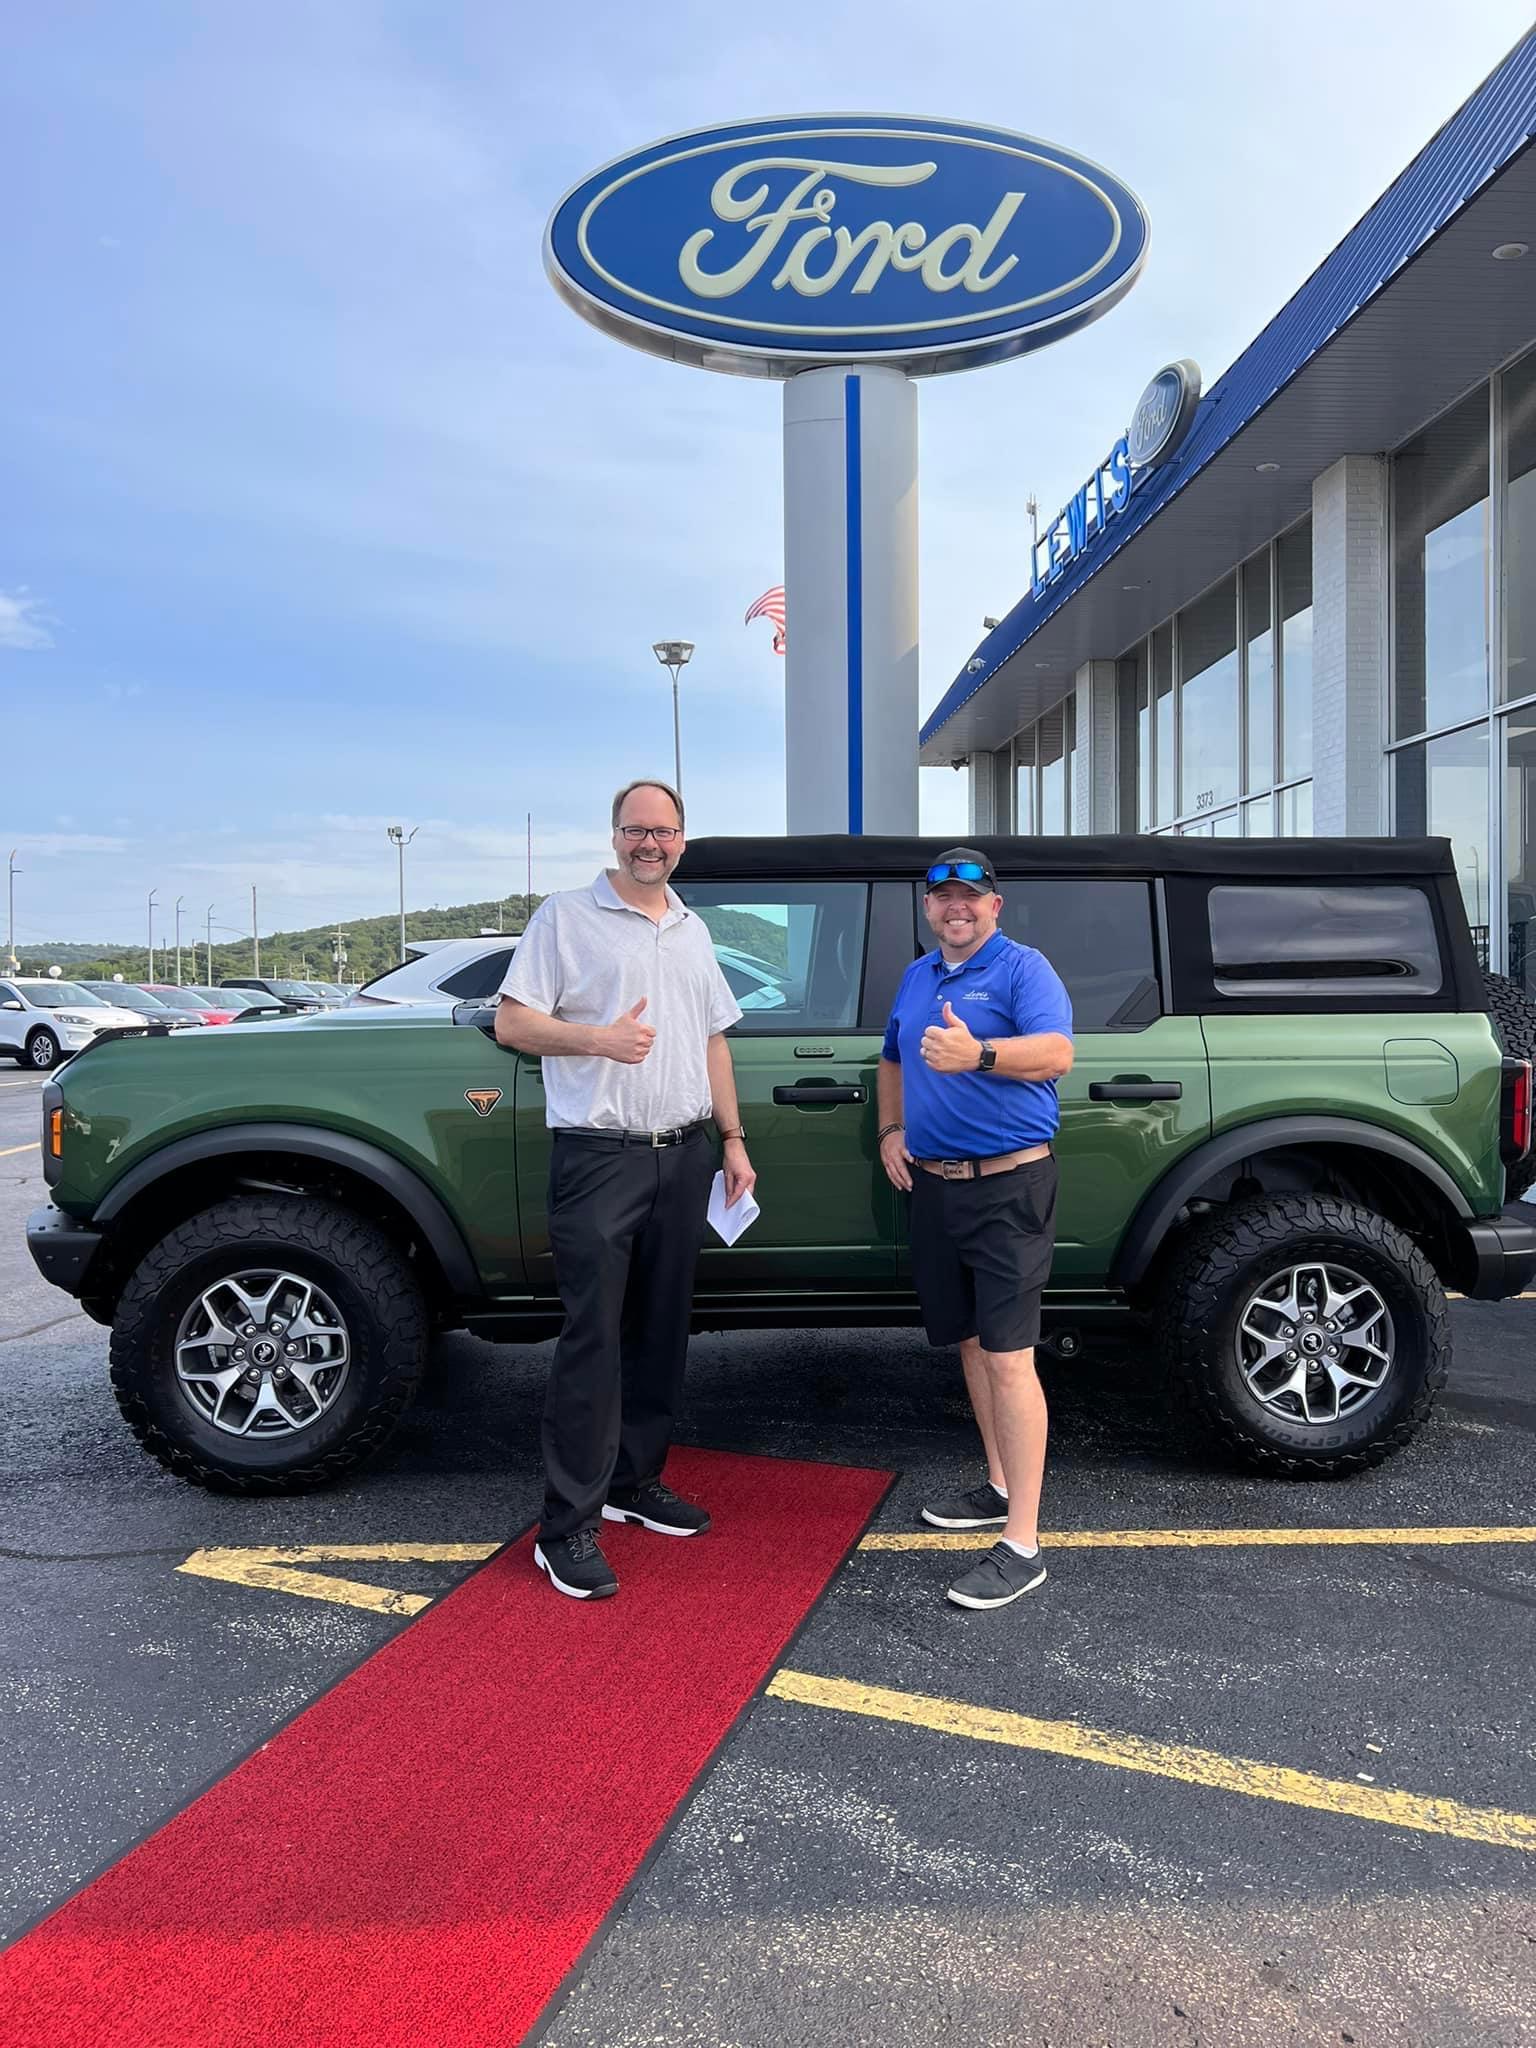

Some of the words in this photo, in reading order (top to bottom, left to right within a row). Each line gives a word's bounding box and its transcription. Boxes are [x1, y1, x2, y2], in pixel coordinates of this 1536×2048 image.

[678, 157, 1027, 299] Ford
[1136, 385, 1167, 451] Ford
[1030, 437, 1132, 601] LEWIS
[1196, 790, 1213, 810] 3373
